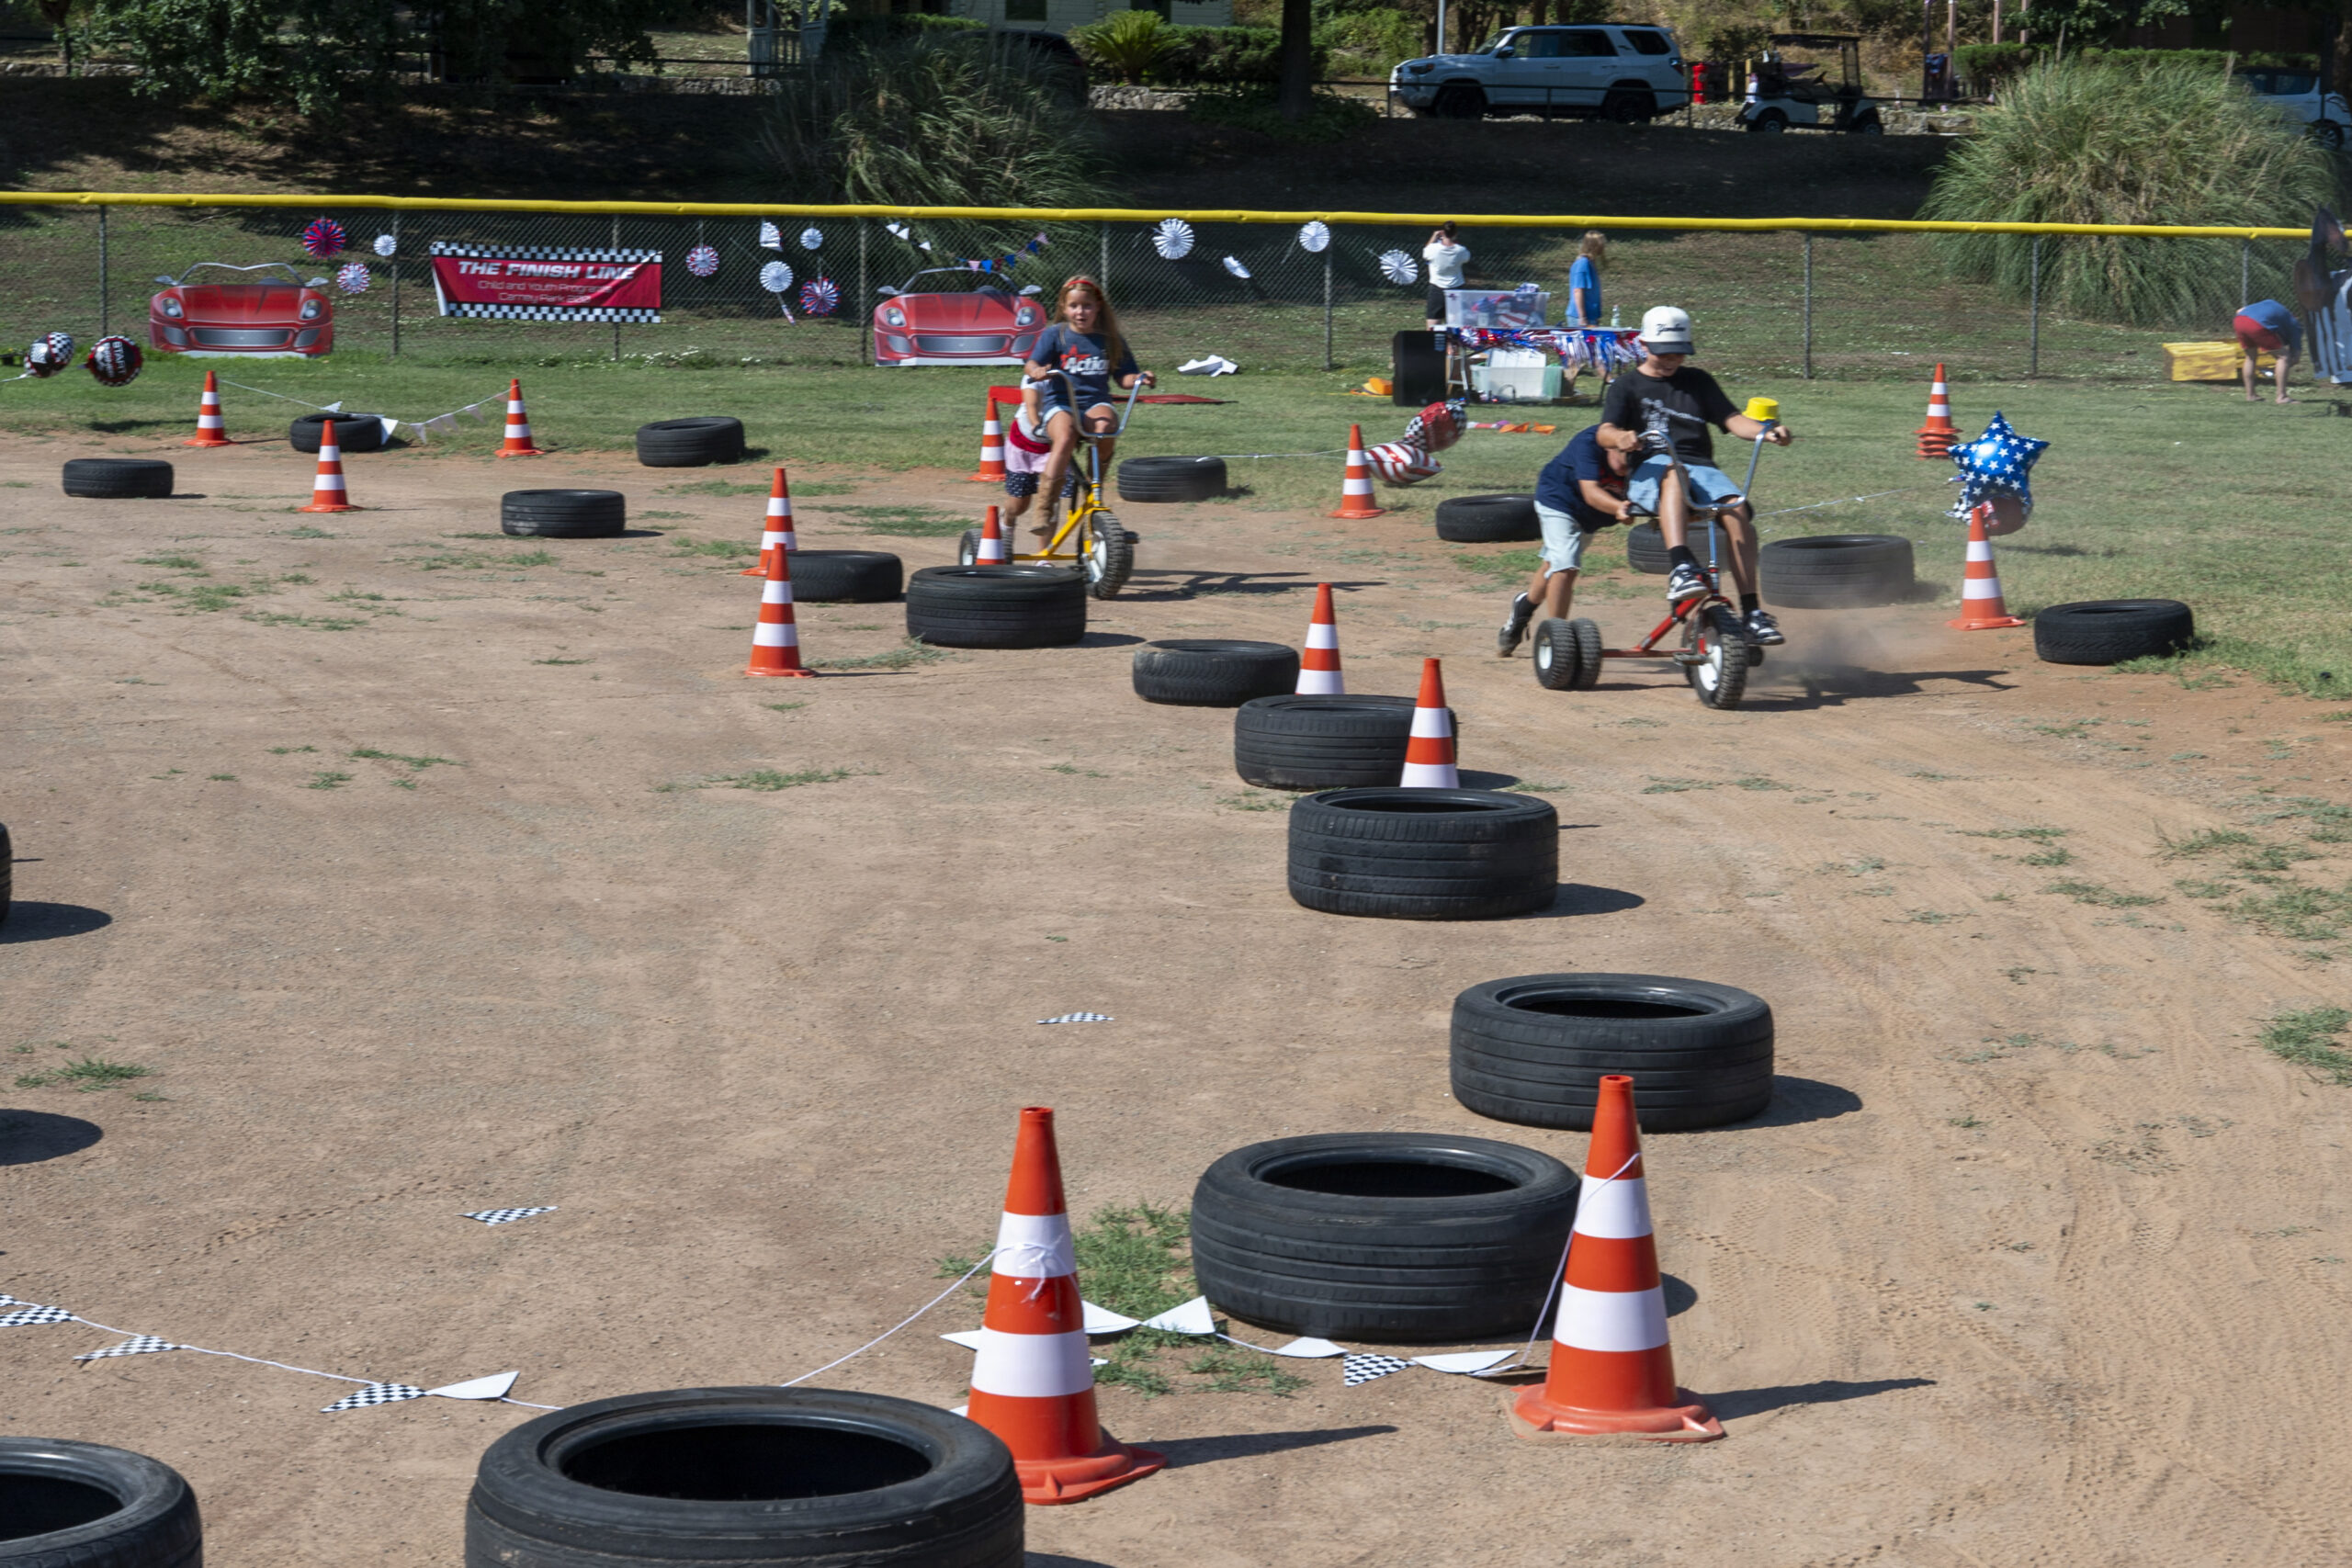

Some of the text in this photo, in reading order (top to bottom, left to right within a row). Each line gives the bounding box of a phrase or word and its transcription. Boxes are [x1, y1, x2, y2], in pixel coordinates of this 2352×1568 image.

[458, 261, 636, 279] THE FINISH LINE
[477, 279, 504, 290] Child
[506, 281, 527, 290] and
[528, 282, 558, 292] Youth
[539, 293, 565, 303] Park
